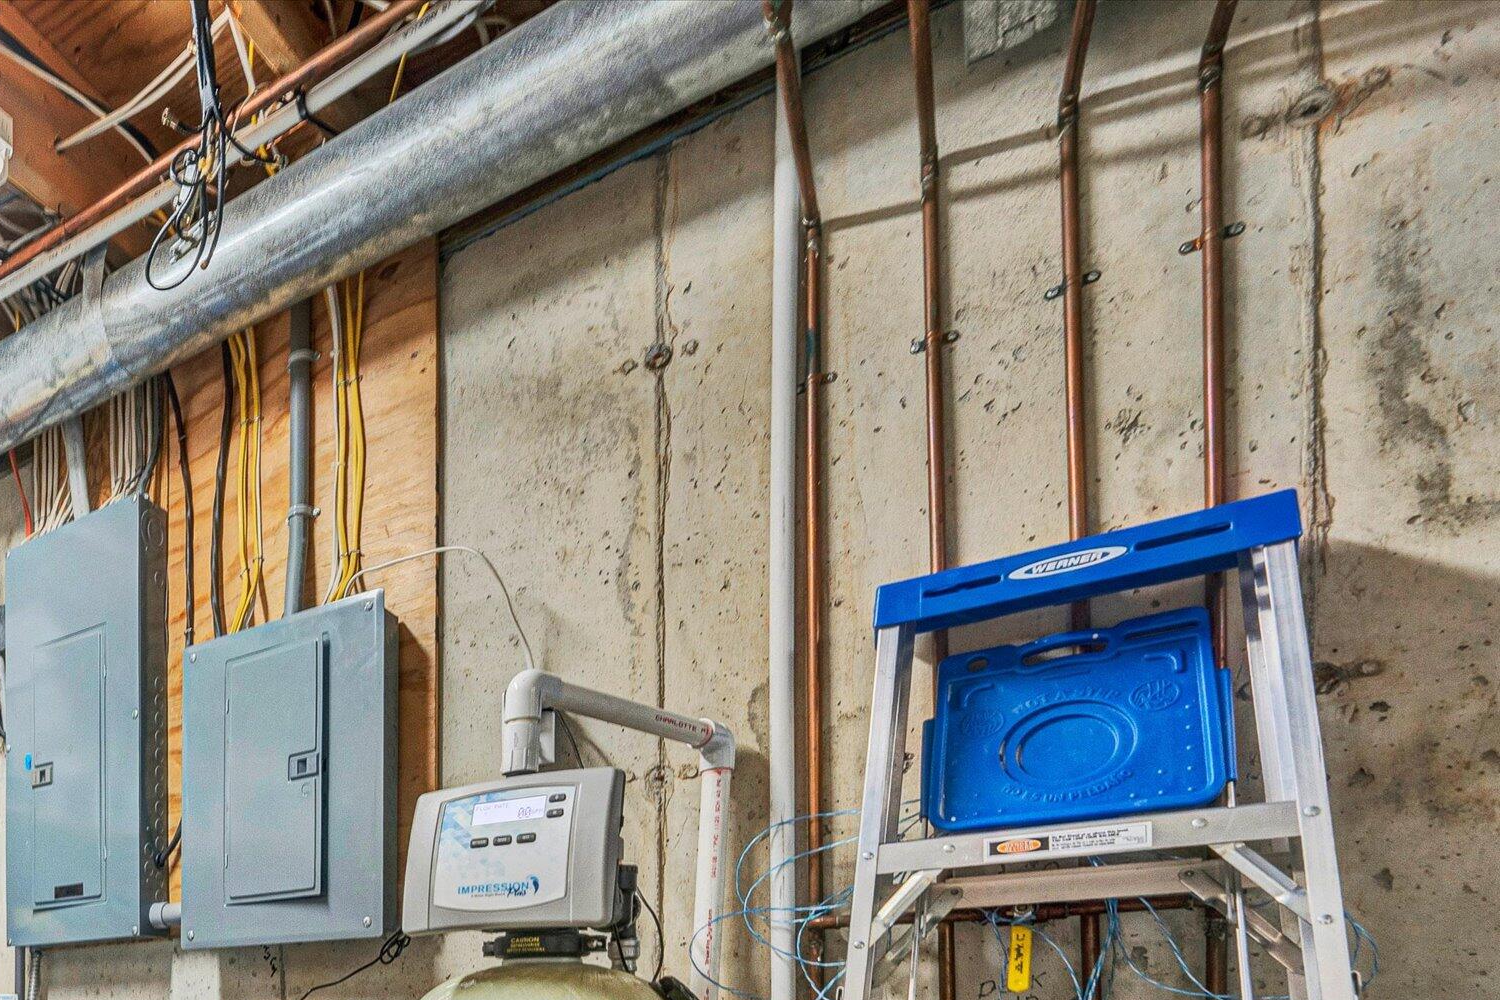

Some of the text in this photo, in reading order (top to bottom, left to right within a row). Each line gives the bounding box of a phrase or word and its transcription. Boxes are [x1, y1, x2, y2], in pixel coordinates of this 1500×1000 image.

[1031, 552, 1103, 575] WERNER
[655, 714, 696, 734] CHARLOTTE
[457, 880, 530, 896] IMPRESSION
